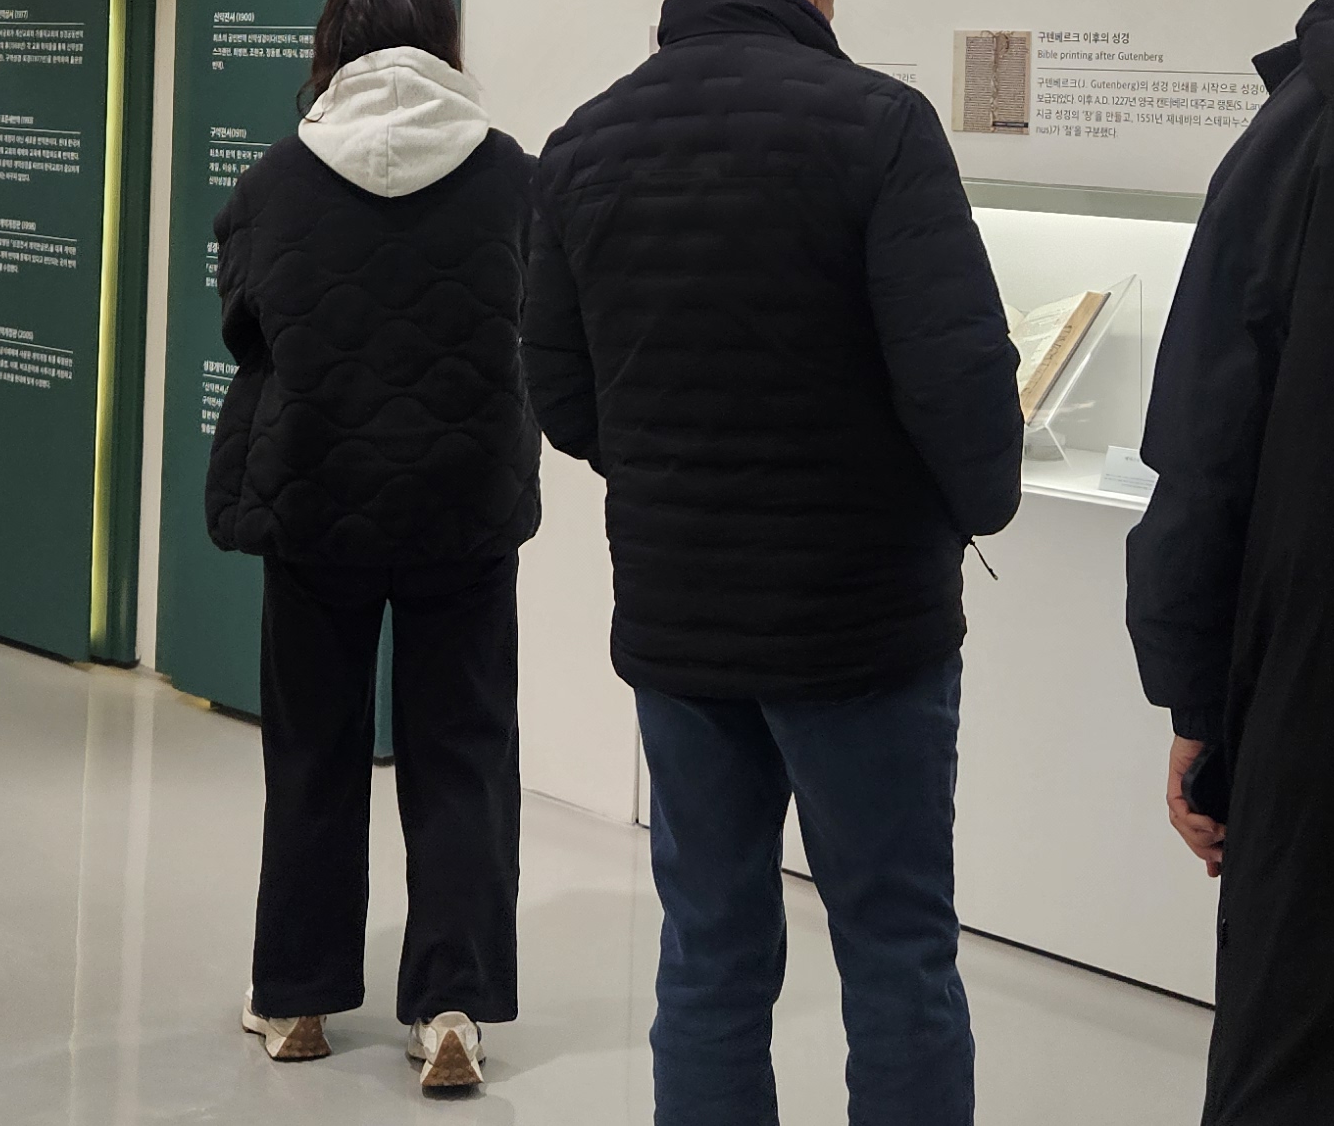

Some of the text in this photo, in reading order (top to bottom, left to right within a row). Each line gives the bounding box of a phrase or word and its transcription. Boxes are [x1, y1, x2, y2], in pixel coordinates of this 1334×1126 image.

[1037, 31, 1130, 45] 구텐베르크 이후의 성경
[1037, 49, 1164, 64] Bible printing after Gutenberg
[1090, 79, 1238, 94] Gutenberg)의 성경 인쇄를 시작으로
